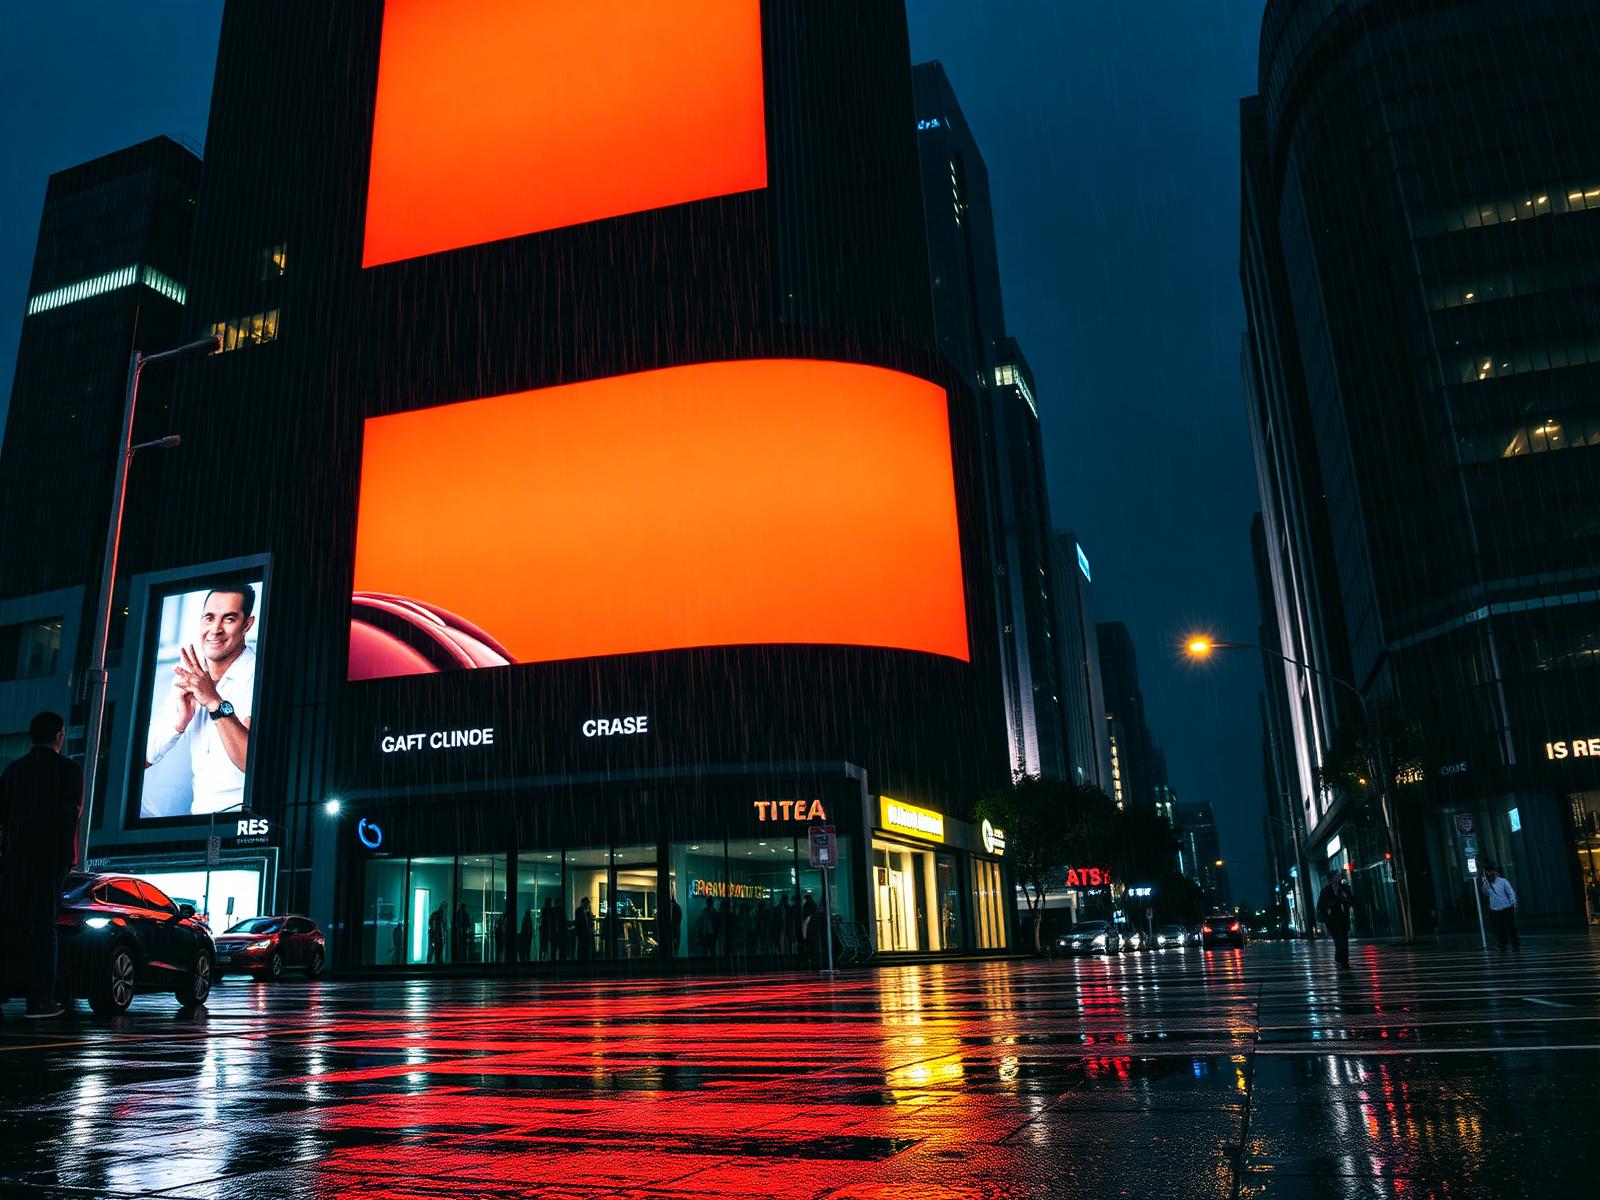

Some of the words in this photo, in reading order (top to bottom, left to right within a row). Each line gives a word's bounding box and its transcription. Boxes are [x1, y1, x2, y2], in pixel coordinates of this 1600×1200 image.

[582, 716, 648, 737] CRASE
[381, 734, 426, 753] GAFT
[1546, 741, 1568, 760] IS
[754, 799, 826, 821] TITEA
[236, 818, 269, 837] RES
